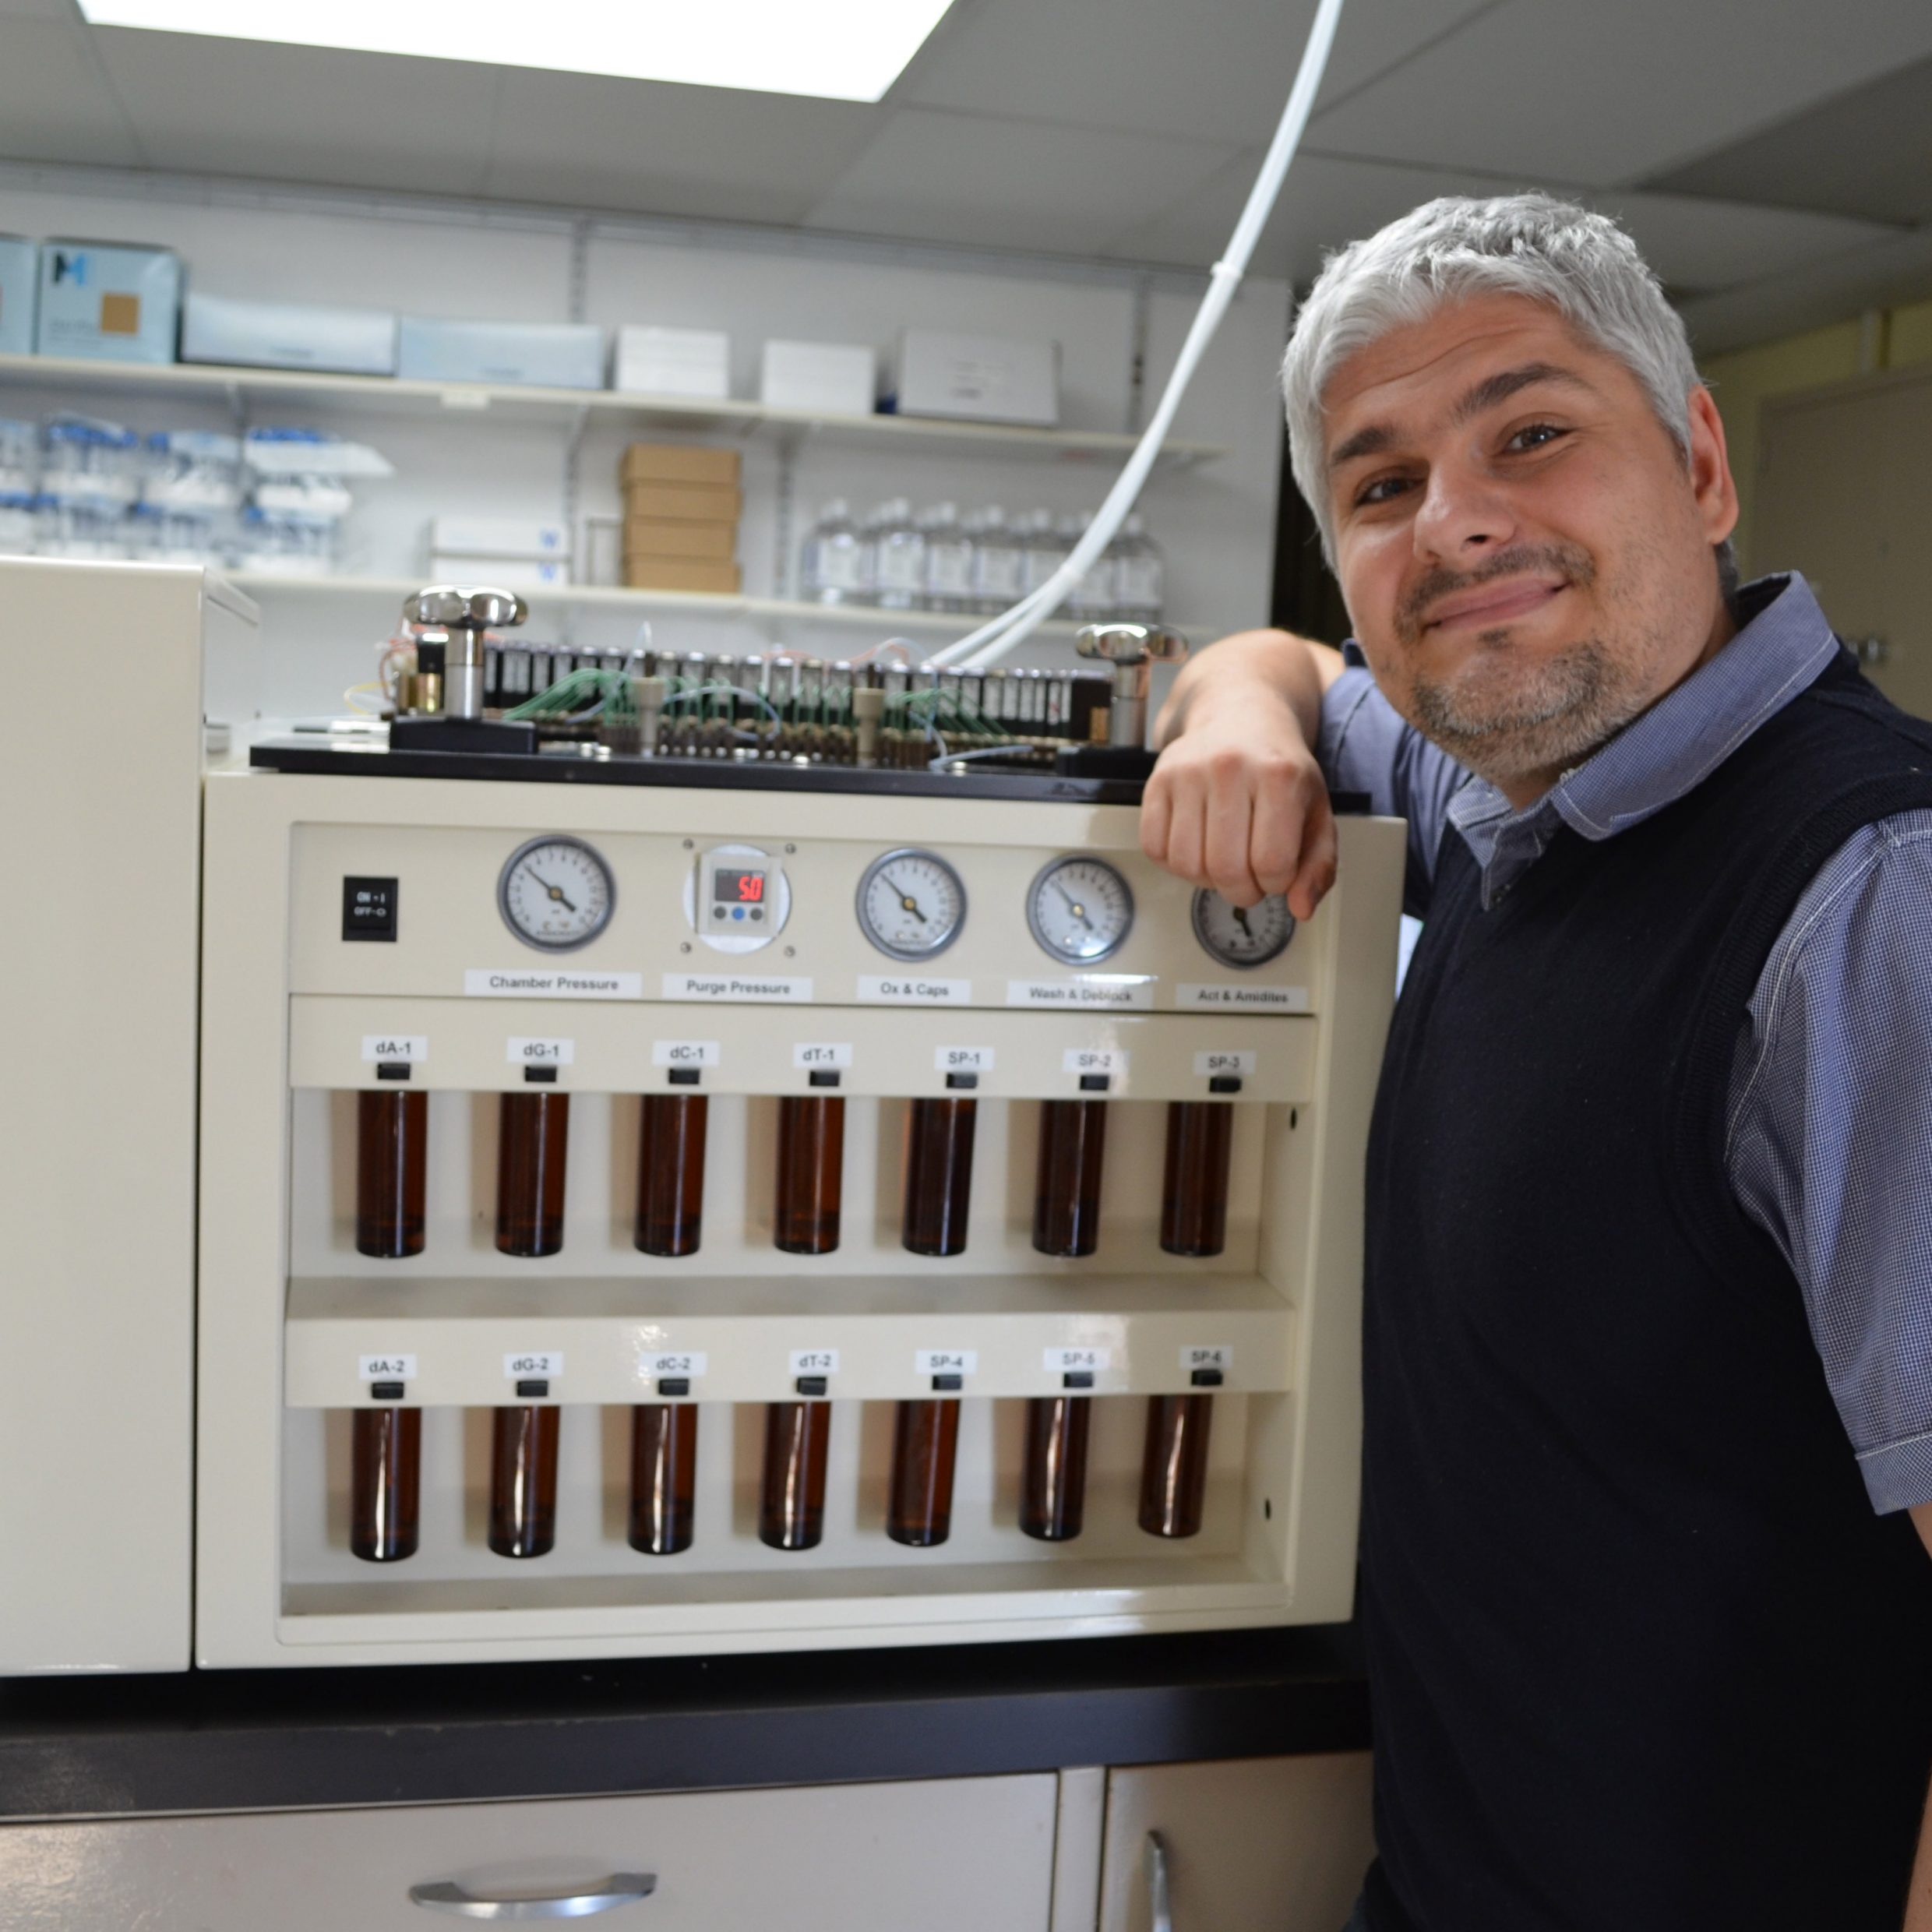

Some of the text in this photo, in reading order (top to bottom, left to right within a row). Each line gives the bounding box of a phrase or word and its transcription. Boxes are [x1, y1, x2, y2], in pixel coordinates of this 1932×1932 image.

[357, 891, 371, 903] ON
[489, 975, 619, 989] Chamber Pressure
[686, 979, 791, 995] Purge Pressure
[880, 982, 949, 998] Ox & Caps
[1029, 987, 1065, 999] Wash
[1070, 988, 1077, 999] &
[1198, 989, 1289, 1003] Act & Amidites
[375, 1042, 411, 1054] dA-1
[524, 1044, 559, 1057] dG-1
[669, 1046, 704, 1059] dC-1
[802, 1049, 835, 1061] dT-1
[947, 1052, 981, 1065] SP-1
[1078, 1053, 1112, 1067] SP-2
[1208, 1056, 1241, 1069] SP-3
[368, 1360, 404, 1373] dA-2
[512, 1357, 548, 1371] dG-2
[655, 1357, 691, 1370] dC-2
[799, 1355, 831, 1368] dT-2
[929, 1356, 963, 1368] SP-4
